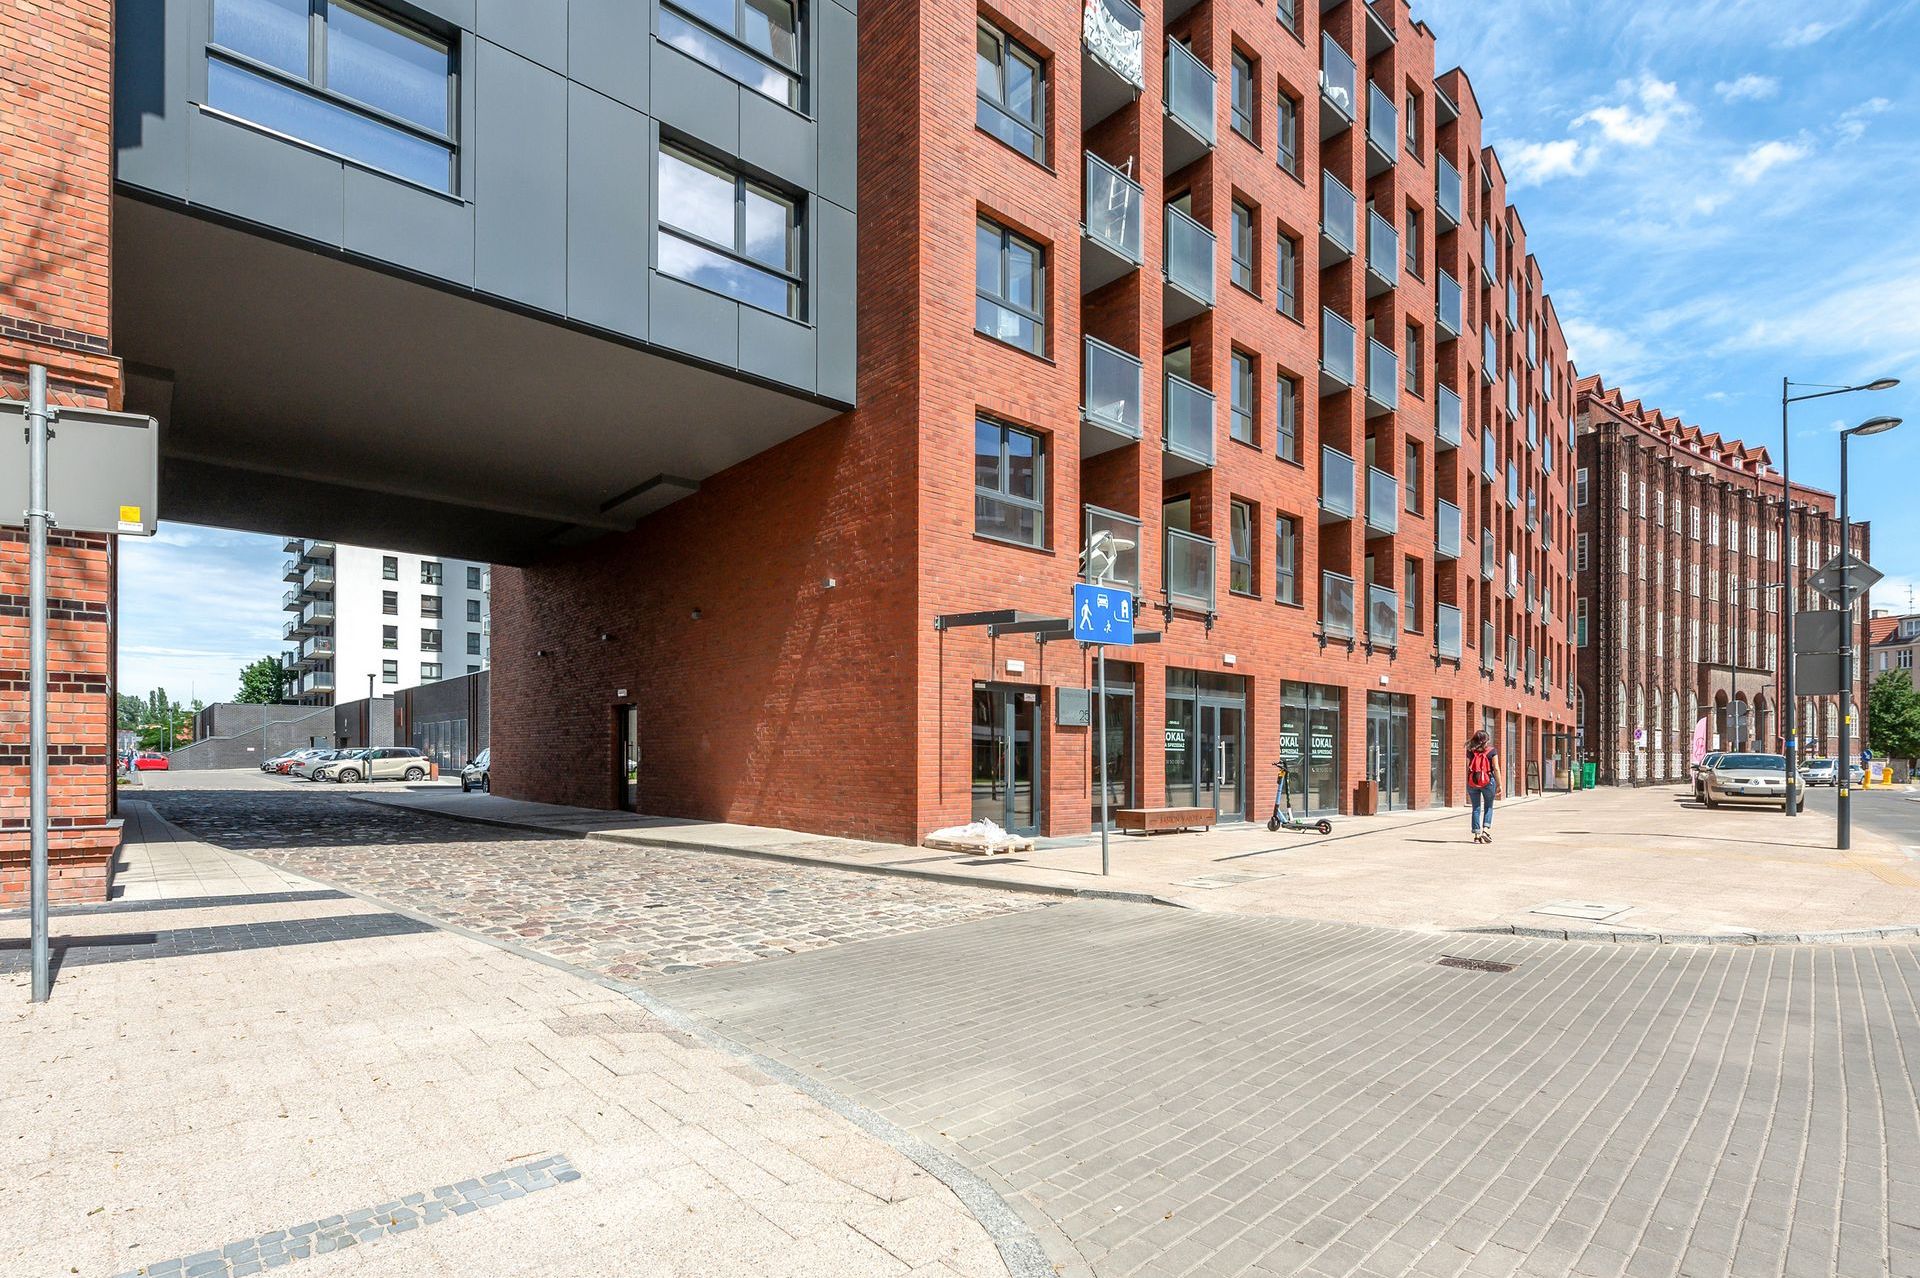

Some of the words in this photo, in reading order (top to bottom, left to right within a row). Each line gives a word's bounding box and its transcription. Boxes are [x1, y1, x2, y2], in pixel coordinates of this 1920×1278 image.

[1165, 732, 1185, 742] OKAL
[1280, 736, 1299, 747] OKAL
[1312, 737, 1333, 748] LOKAL
